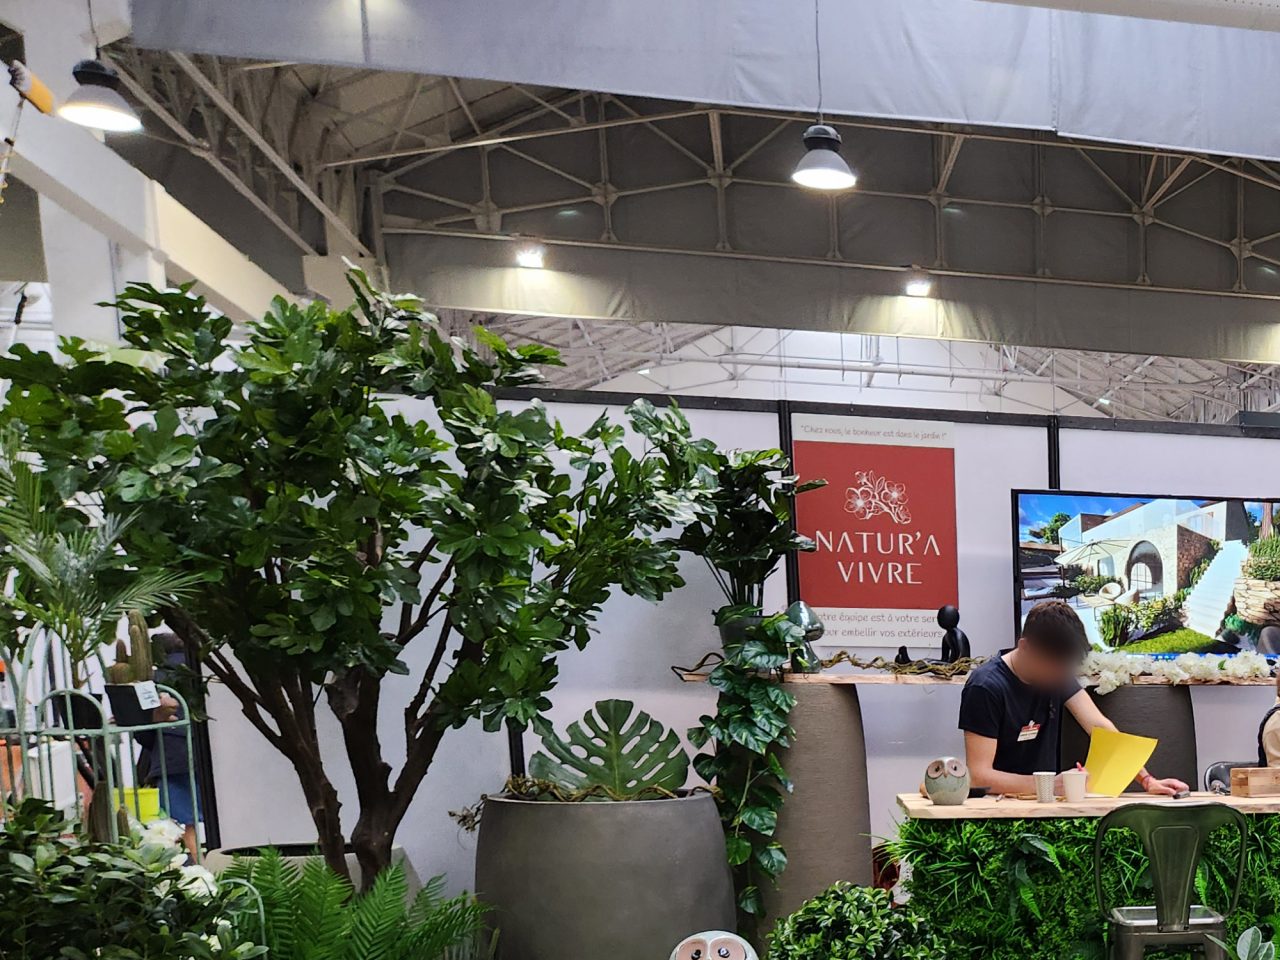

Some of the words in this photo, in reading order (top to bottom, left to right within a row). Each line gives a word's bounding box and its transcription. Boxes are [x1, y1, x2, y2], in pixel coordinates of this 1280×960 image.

[844, 427, 851, 436] le
[853, 428, 881, 438] bonheur
[883, 430, 895, 438] est
[896, 429, 912, 439] dans
[913, 430, 920, 439] le
[920, 431, 940, 441] jardin
[815, 530, 940, 556] NATUR'A
[837, 561, 922, 585] VIVRE
[820, 613, 837, 621] otre
[839, 612, 869, 623] équipe
[870, 613, 886, 622] est
[895, 615, 919, 623] votre
[841, 628, 877, 637] embellir
[880, 630, 896, 638] vos
[898, 628, 943, 638] extérieurs
